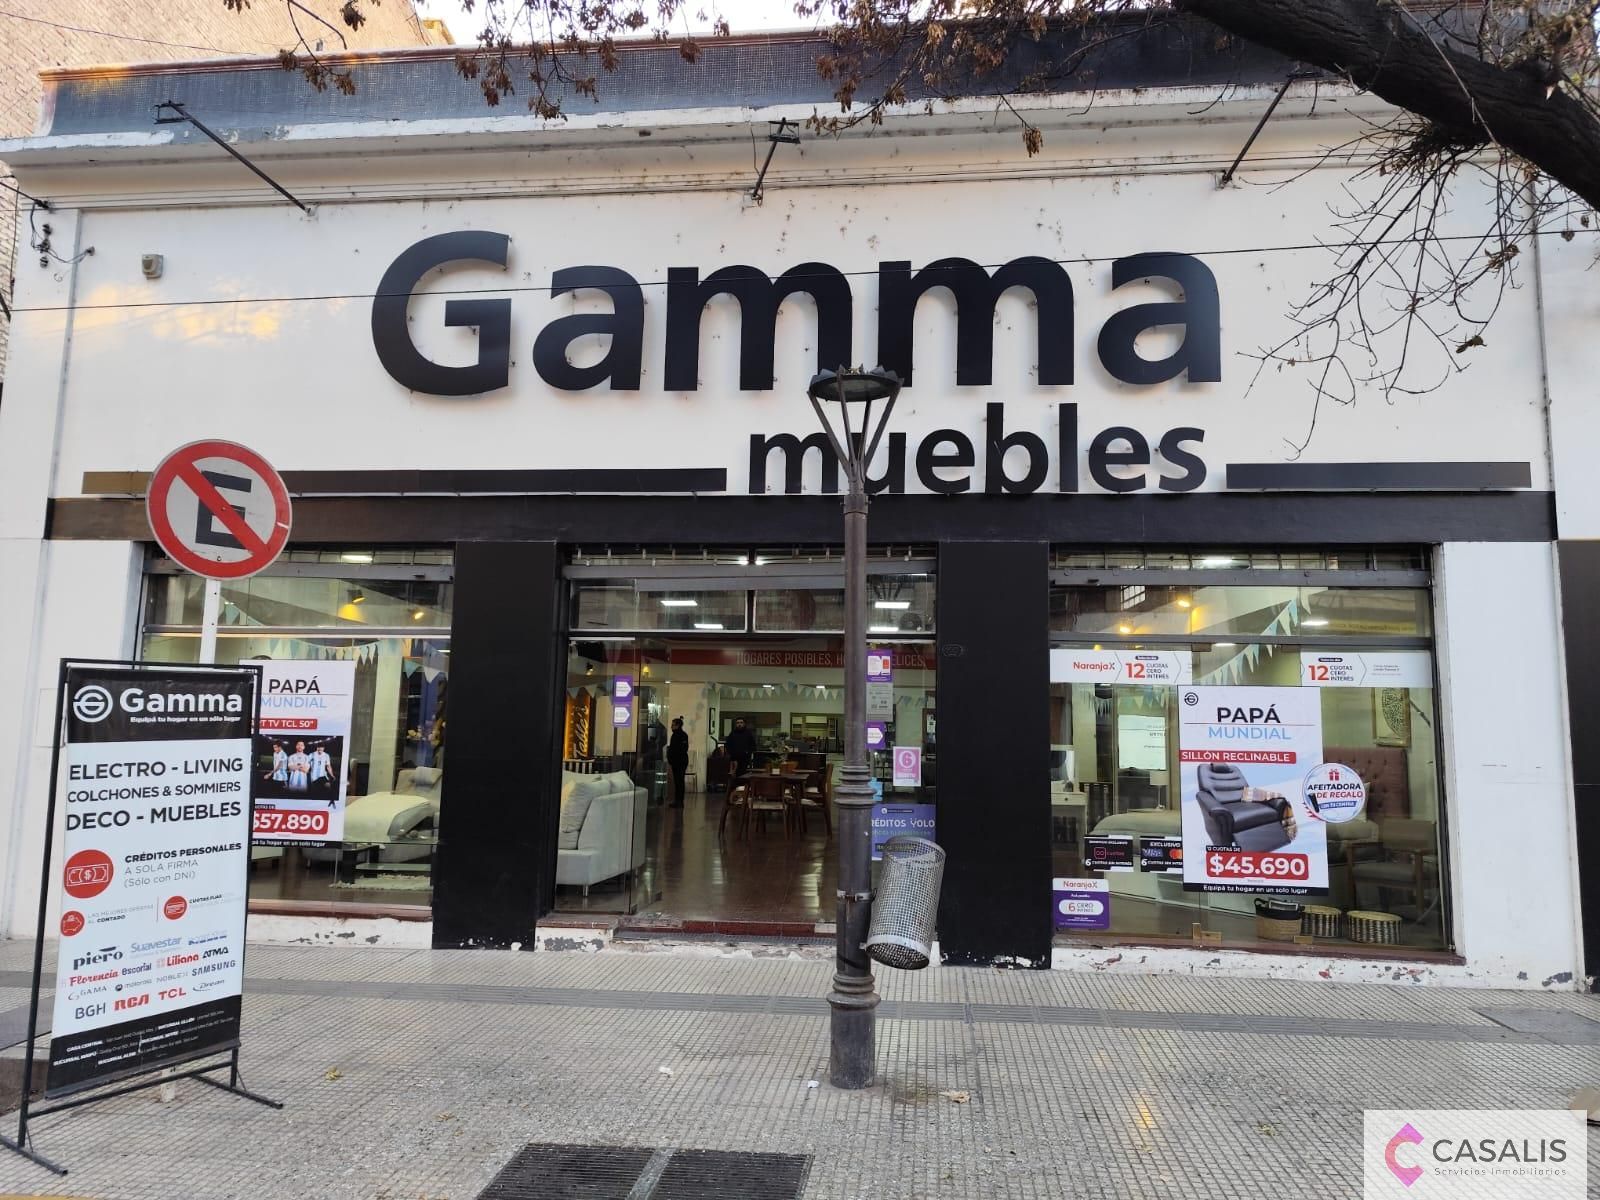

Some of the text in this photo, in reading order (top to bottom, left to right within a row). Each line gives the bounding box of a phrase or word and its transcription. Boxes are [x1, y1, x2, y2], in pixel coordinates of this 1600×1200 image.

[371, 230, 1222, 396] Gamma
[748, 402, 1207, 494] muebles
[1125, 662, 1146, 679] 12
[1308, 665, 1330, 681] 12
[268, 675, 321, 693] PAPÁ
[120, 687, 243, 713] Gamma
[260, 696, 328, 708] MUNDIAL
[1216, 703, 1281, 723] PAPÁ
[268, 719, 279, 727] TV
[282, 719, 298, 728] TCL
[1208, 726, 1292, 740] MUNDIAL
[1181, 750, 1291, 762] SILLÓN RECLINABLE
[69, 761, 166, 780] ELECTRO
[184, 758, 243, 775] LIVING
[67, 781, 241, 803] COLCHONES & SOMMIERS
[1307, 783, 1361, 791] AFEITADORA
[66, 810, 131, 831] DECO
[150, 801, 242, 824] MUEBLES
[253, 810, 325, 831] $57.890
[124, 850, 177, 863] CRÉDITOS
[180, 842, 242, 857] PERSONALES
[125, 859, 199, 875] A SOLA FIRMA
[1085, 858, 1092, 866] 6
[1141, 858, 1148, 866] 6
[1209, 852, 1306, 876] $45.690
[153, 875, 171, 883] con
[174, 870, 196, 881] DNI)
[1203, 884, 1226, 892] Equipá
[1235, 885, 1255, 893] hogar
[73, 946, 124, 971] piero
[130, 936, 183, 953] Suavestar
[69, 969, 120, 987] Florencia
[121, 962, 152, 977] escorial
[166, 952, 199, 967] Liliana
[202, 946, 229, 959] ATMA
[191, 959, 237, 977] SAMSUNG
[74, 1002, 107, 1020] BGH
[114, 993, 150, 1011] RCA
[158, 987, 187, 1001] TCL
